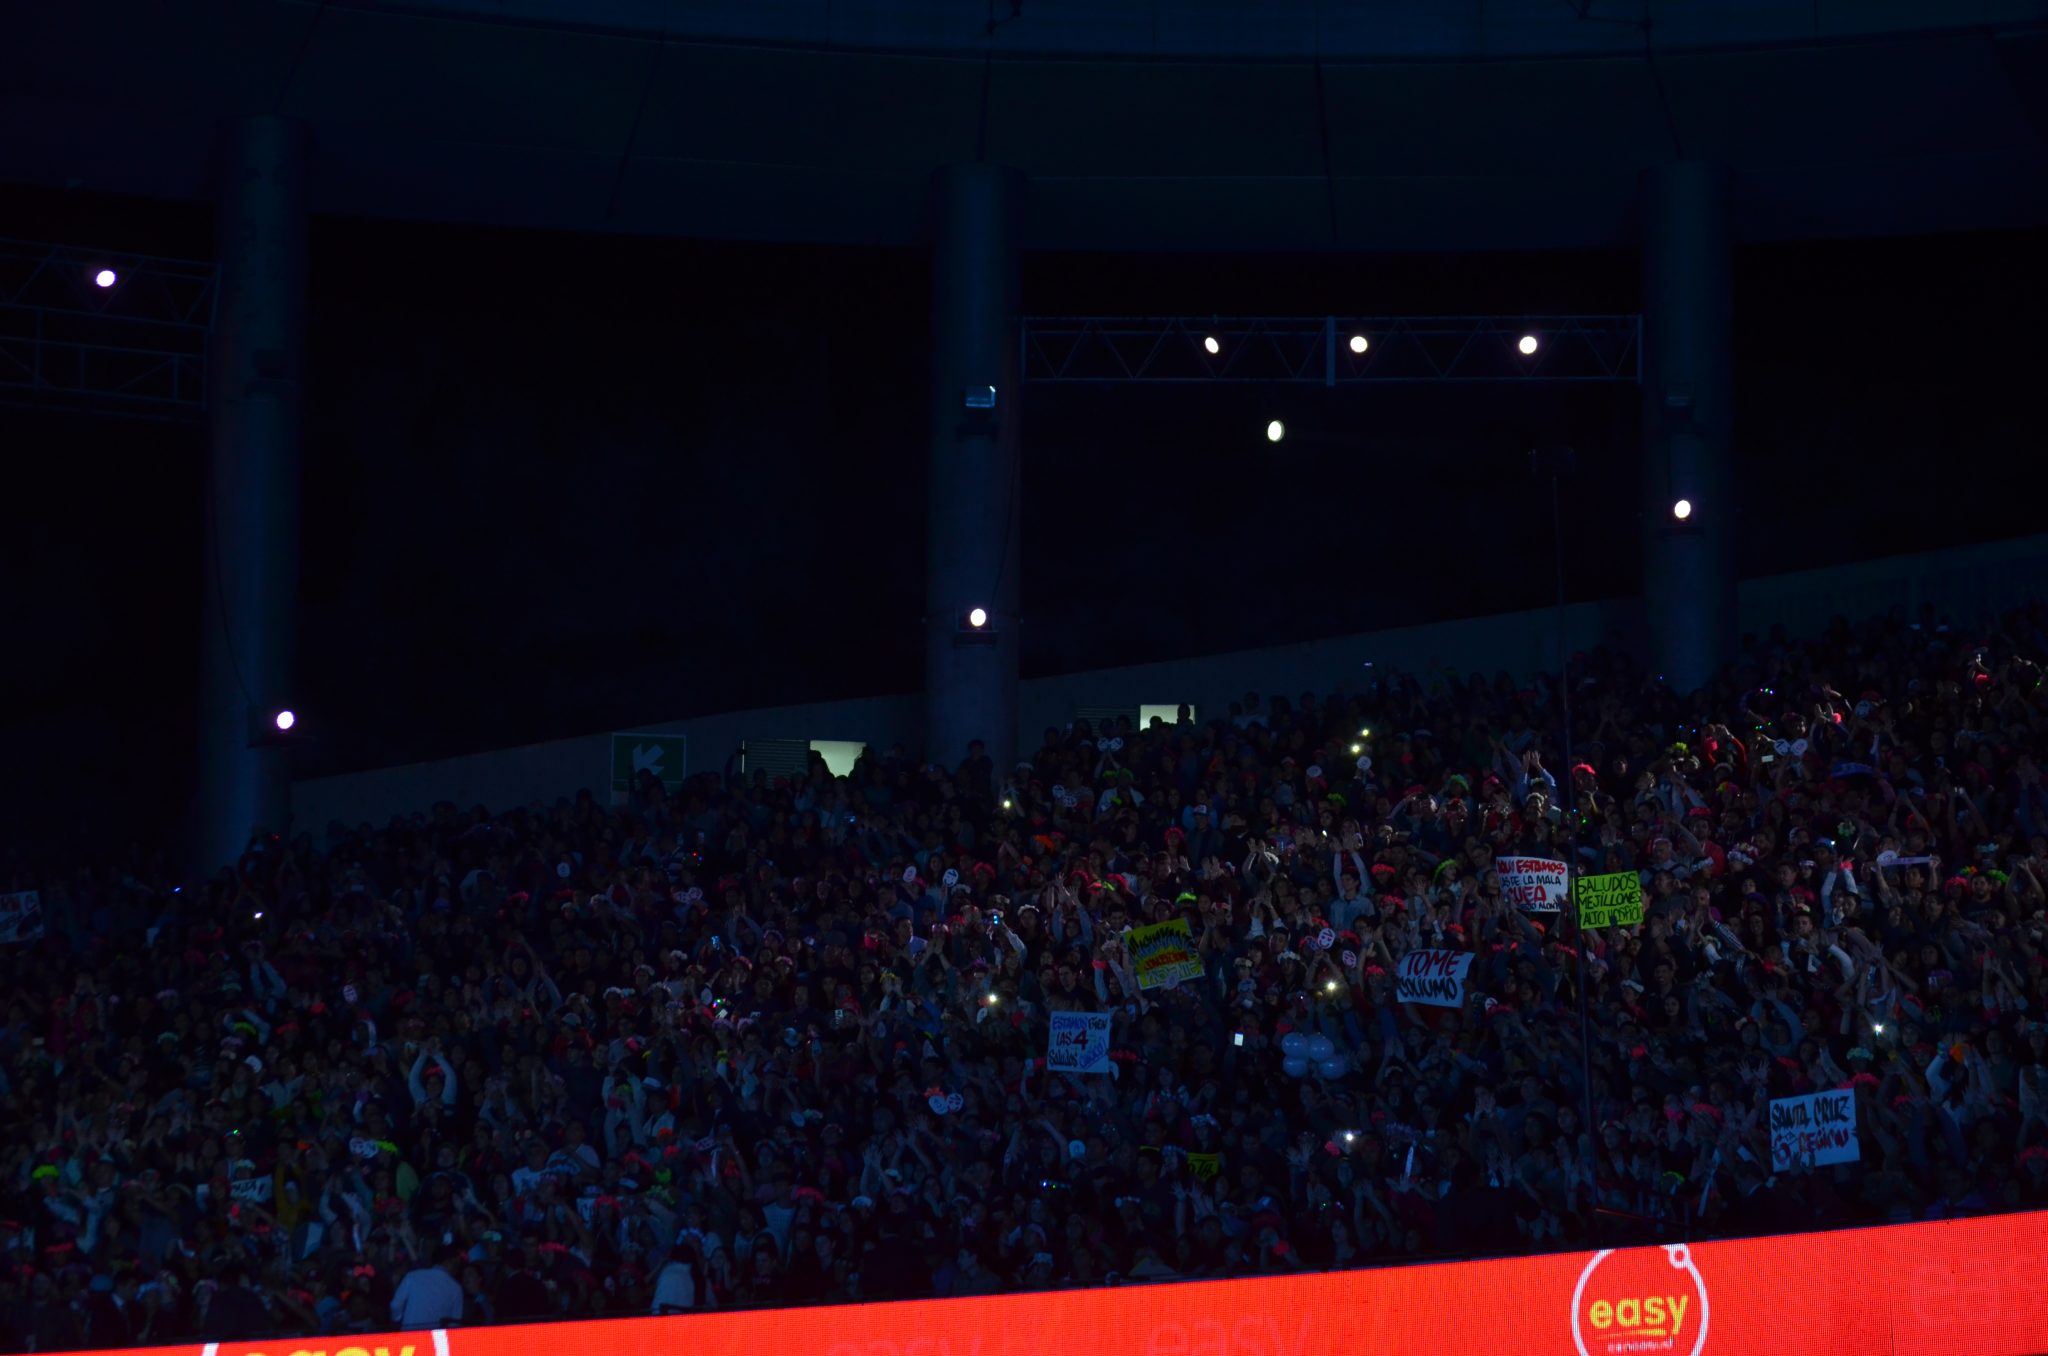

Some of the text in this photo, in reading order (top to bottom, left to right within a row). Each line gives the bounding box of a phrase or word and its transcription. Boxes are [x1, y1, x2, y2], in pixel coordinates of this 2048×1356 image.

[1516, 859, 1566, 876] ESTAMOS
[1536, 874, 1561, 886] MALA
[1578, 873, 1637, 895] SALUDOS
[1579, 890, 1641, 909] MEJILLONES
[1583, 911, 1605, 926] ALTO
[1073, 1028, 1088, 1050] 4
[1814, 1096, 1849, 1127] CRUZ
[1590, 1296, 1688, 1335] easy
